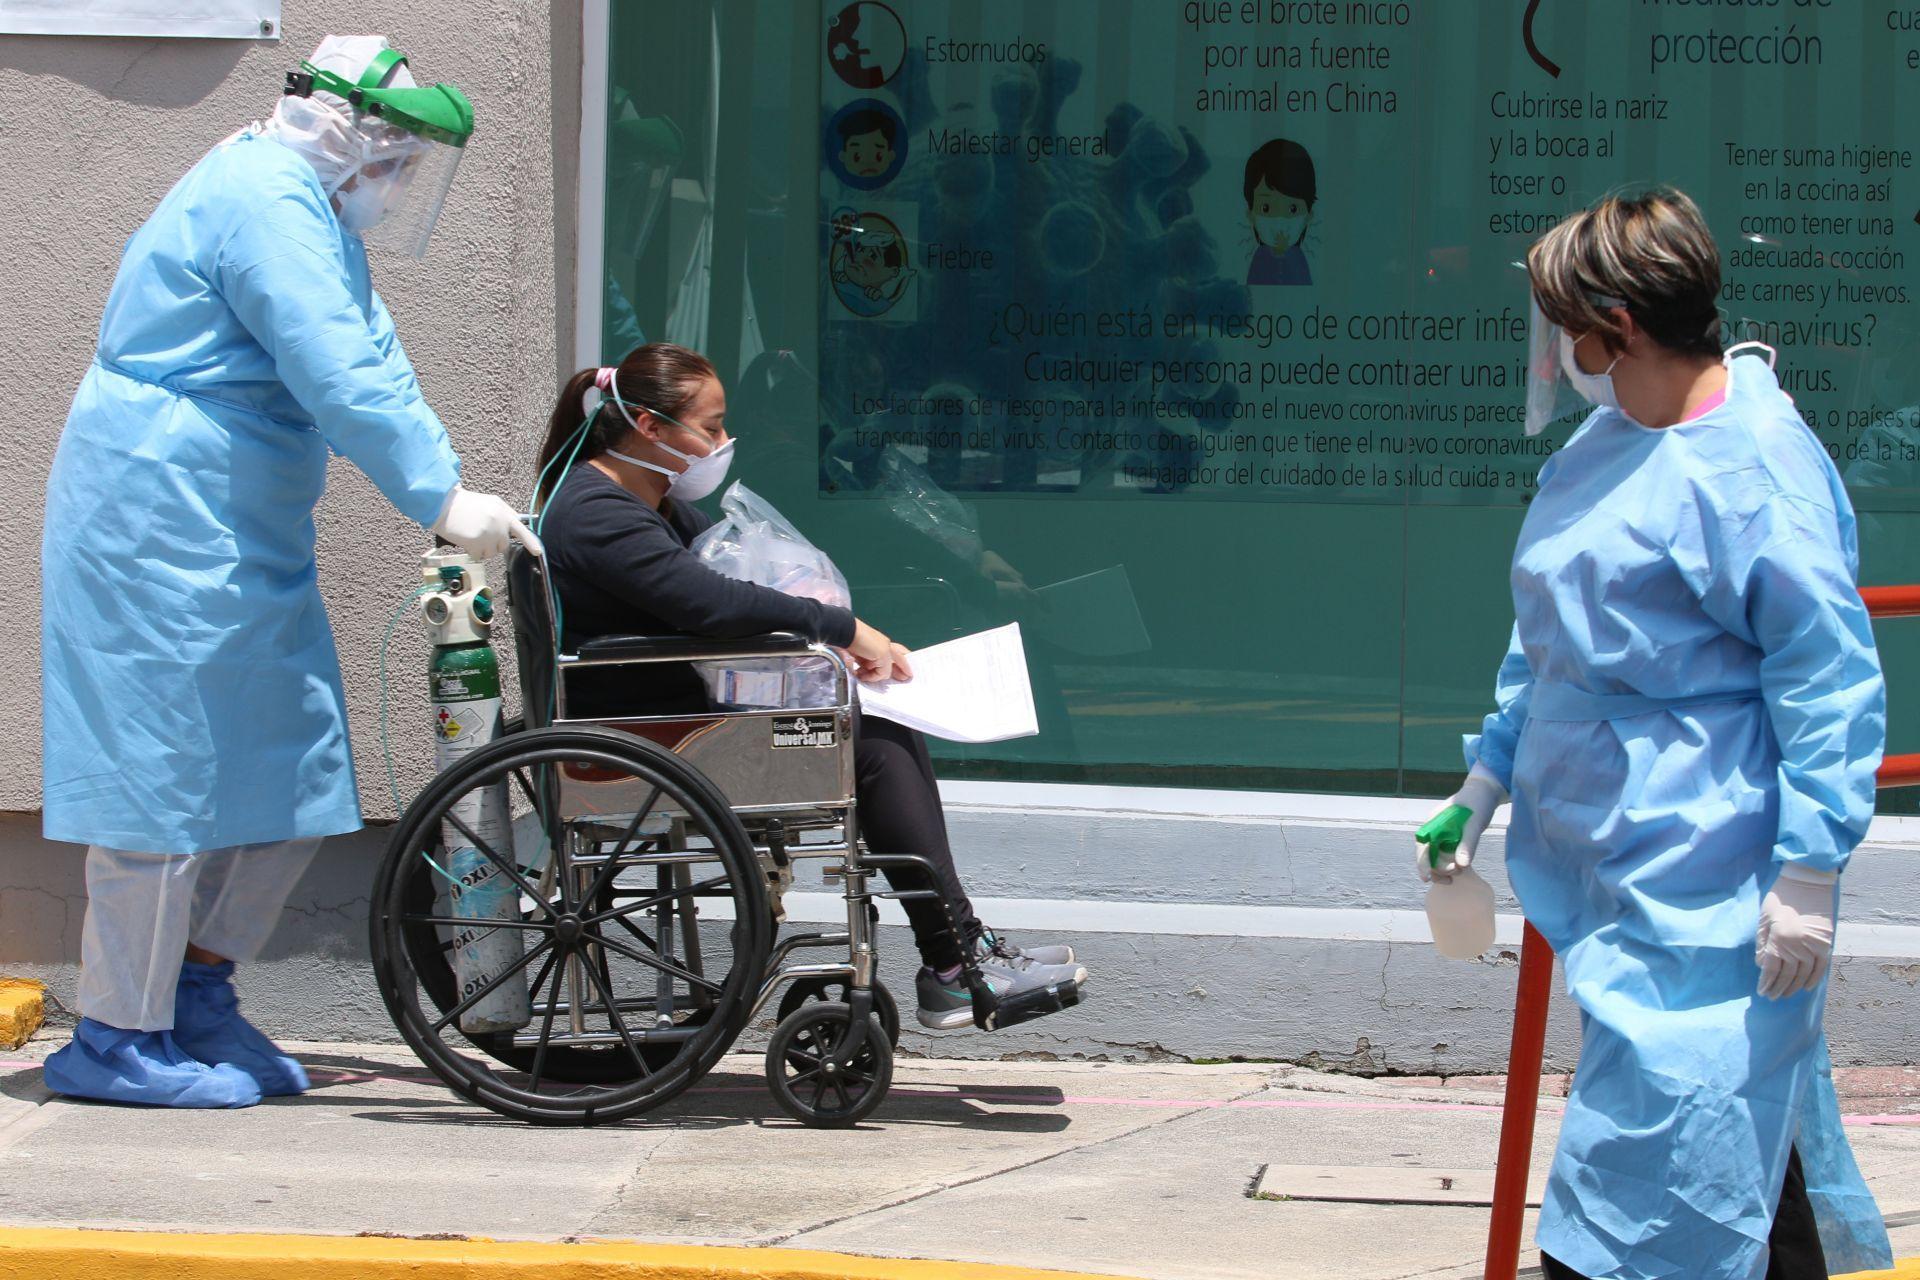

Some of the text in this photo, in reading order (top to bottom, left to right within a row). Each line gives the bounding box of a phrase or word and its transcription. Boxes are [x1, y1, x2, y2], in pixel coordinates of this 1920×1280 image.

[1184, 0, 1232, 32] que
[1241, 0, 1261, 24] el
[1271, 0, 1337, 24] brote
[1887, 10, 1920, 31] cua
[925, 35, 1046, 63] Estornudos
[1204, 37, 1390, 76] por una fuente
[1651, 24, 1822, 74] protección
[1196, 81, 1397, 113] animal en China
[1490, 90, 1669, 120] Cubrirse la nariz
[928, 128, 1109, 163] Malestar general
[1489, 129, 1614, 164] y la boca al
[1724, 143, 1912, 174] Tener suma higiene
[1489, 171, 1566, 196] toser o
[1744, 176, 1892, 201] en la cocina así
[1740, 212, 1894, 236] como tener una
[928, 242, 993, 270] Fiebre
[1729, 244, 1904, 269] adecuada cocción
[1721, 276, 1911, 308] de carnes y huevos.
[988, 302, 1877, 348] ¿Quién está en riesgo de contraer infe oronavirus?
[1024, 352, 1143, 392] Cualquier
[1152, 359, 1251, 390] persona
[1261, 353, 1340, 392] puede
[1348, 358, 1453, 387] contraer
[1460, 363, 1506, 388] una
[1774, 361, 1838, 392] virus.
[852, 393, 884, 416] Los
[890, 393, 964, 416] factores
[968, 393, 992, 416] de
[999, 394, 1057, 423] riesgo
[1063, 398, 1104, 421] para
[1111, 394, 1126, 417] la
[1131, 394, 1216, 418] infección
[1219, 401, 1256, 419] con
[1262, 396, 1278, 419] el
[1285, 402, 1344, 420] nuevo
[1349, 399, 1458, 422] coronavirus
[1827, 410, 1840, 427] o
[1847, 404, 1904, 433] países
[855, 426, 961, 448] transmisión
[967, 425, 996, 449] del
[1057, 426, 1142, 451] Contacto
[1147, 433, 1182, 451] con
[1188, 427, 1256, 457] alguien
[1262, 435, 1298, 458] que
[1305, 431, 1351, 453] tiene
[1356, 430, 1373, 454] el
[1380, 436, 1438, 454] nuevo
[1443, 432, 1553, 456] coronavirus
[1846, 437, 1869, 460] de
[1877, 437, 1892, 460] la
[1124, 462, 1220, 489] trabajador
[1225, 462, 1253, 484] del
[1260, 462, 1336, 485] cuidado
[1342, 463, 1366, 485] de
[1372, 463, 1387, 486] la
[1394, 464, 1443, 487] salud
[1449, 465, 1499, 487] cuida
[1505, 471, 1515, 487] a
